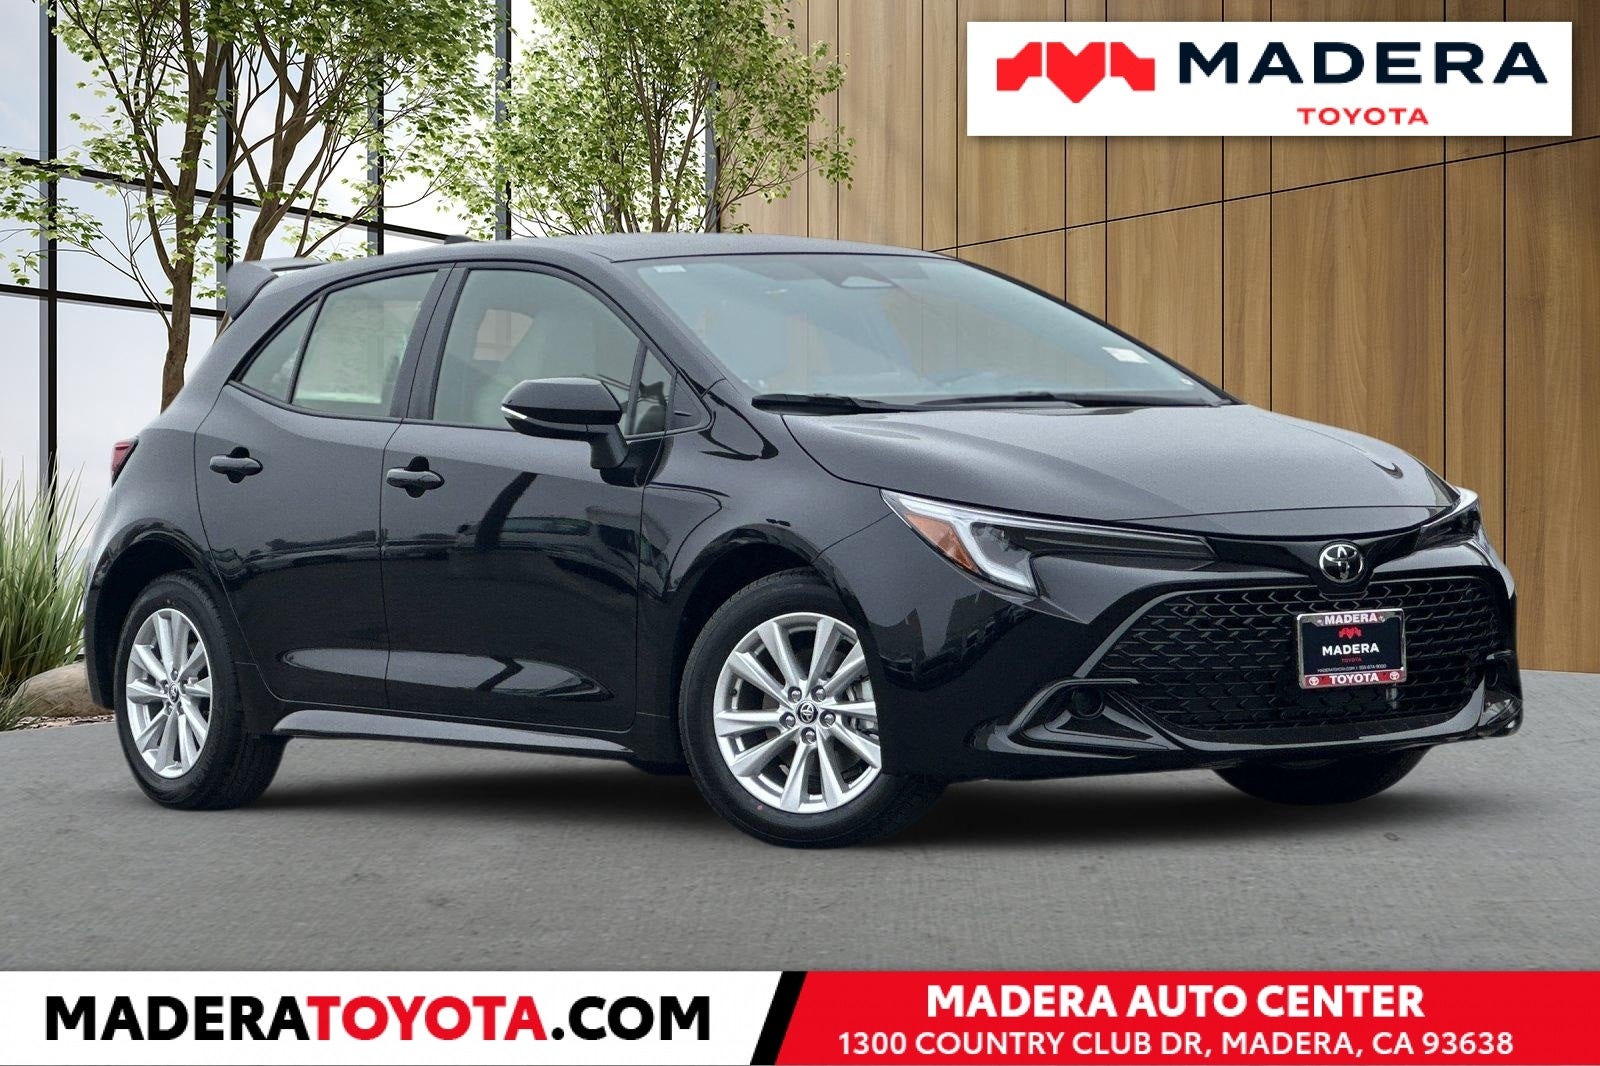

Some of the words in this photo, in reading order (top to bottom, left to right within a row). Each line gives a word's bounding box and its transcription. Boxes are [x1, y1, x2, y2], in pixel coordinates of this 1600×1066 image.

[1324, 613, 1378, 625] MADERA
[1321, 642, 1380, 656] MADERA
[1329, 672, 1380, 685] TOYOTA
